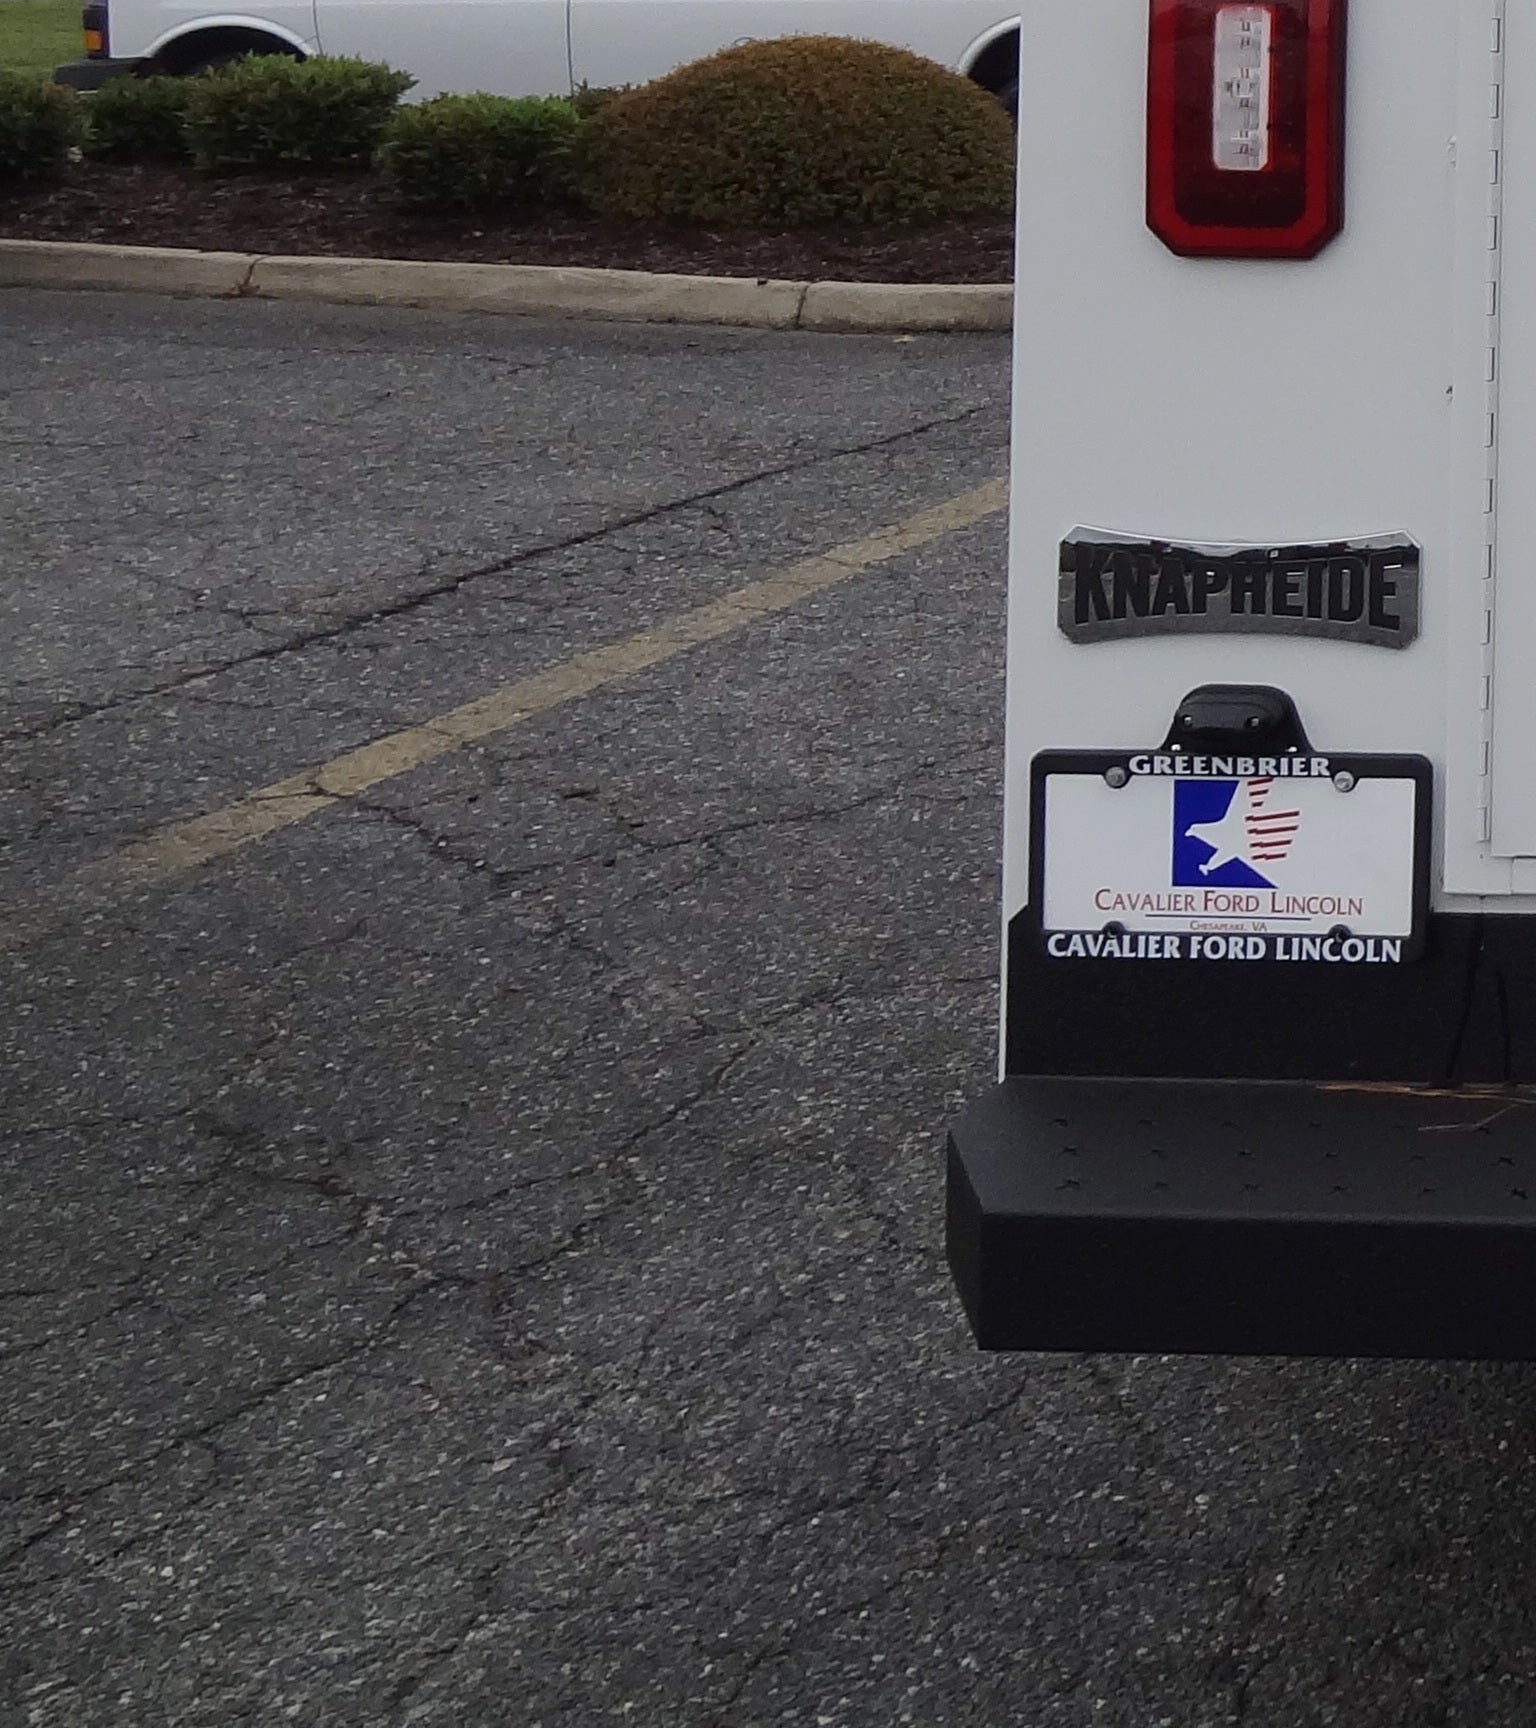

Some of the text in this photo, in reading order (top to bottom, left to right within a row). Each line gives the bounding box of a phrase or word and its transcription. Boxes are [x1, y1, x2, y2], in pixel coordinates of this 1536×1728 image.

[1072, 546, 1404, 632] KNAPHEIDE
[1128, 754, 1331, 777] GREENBRIER
[1094, 888, 1363, 916] CAVALIER FORD LINCOLN
[1251, 921, 1268, 932] VA
[1047, 933, 1402, 964] CAVALIER FORD LINCOLN
